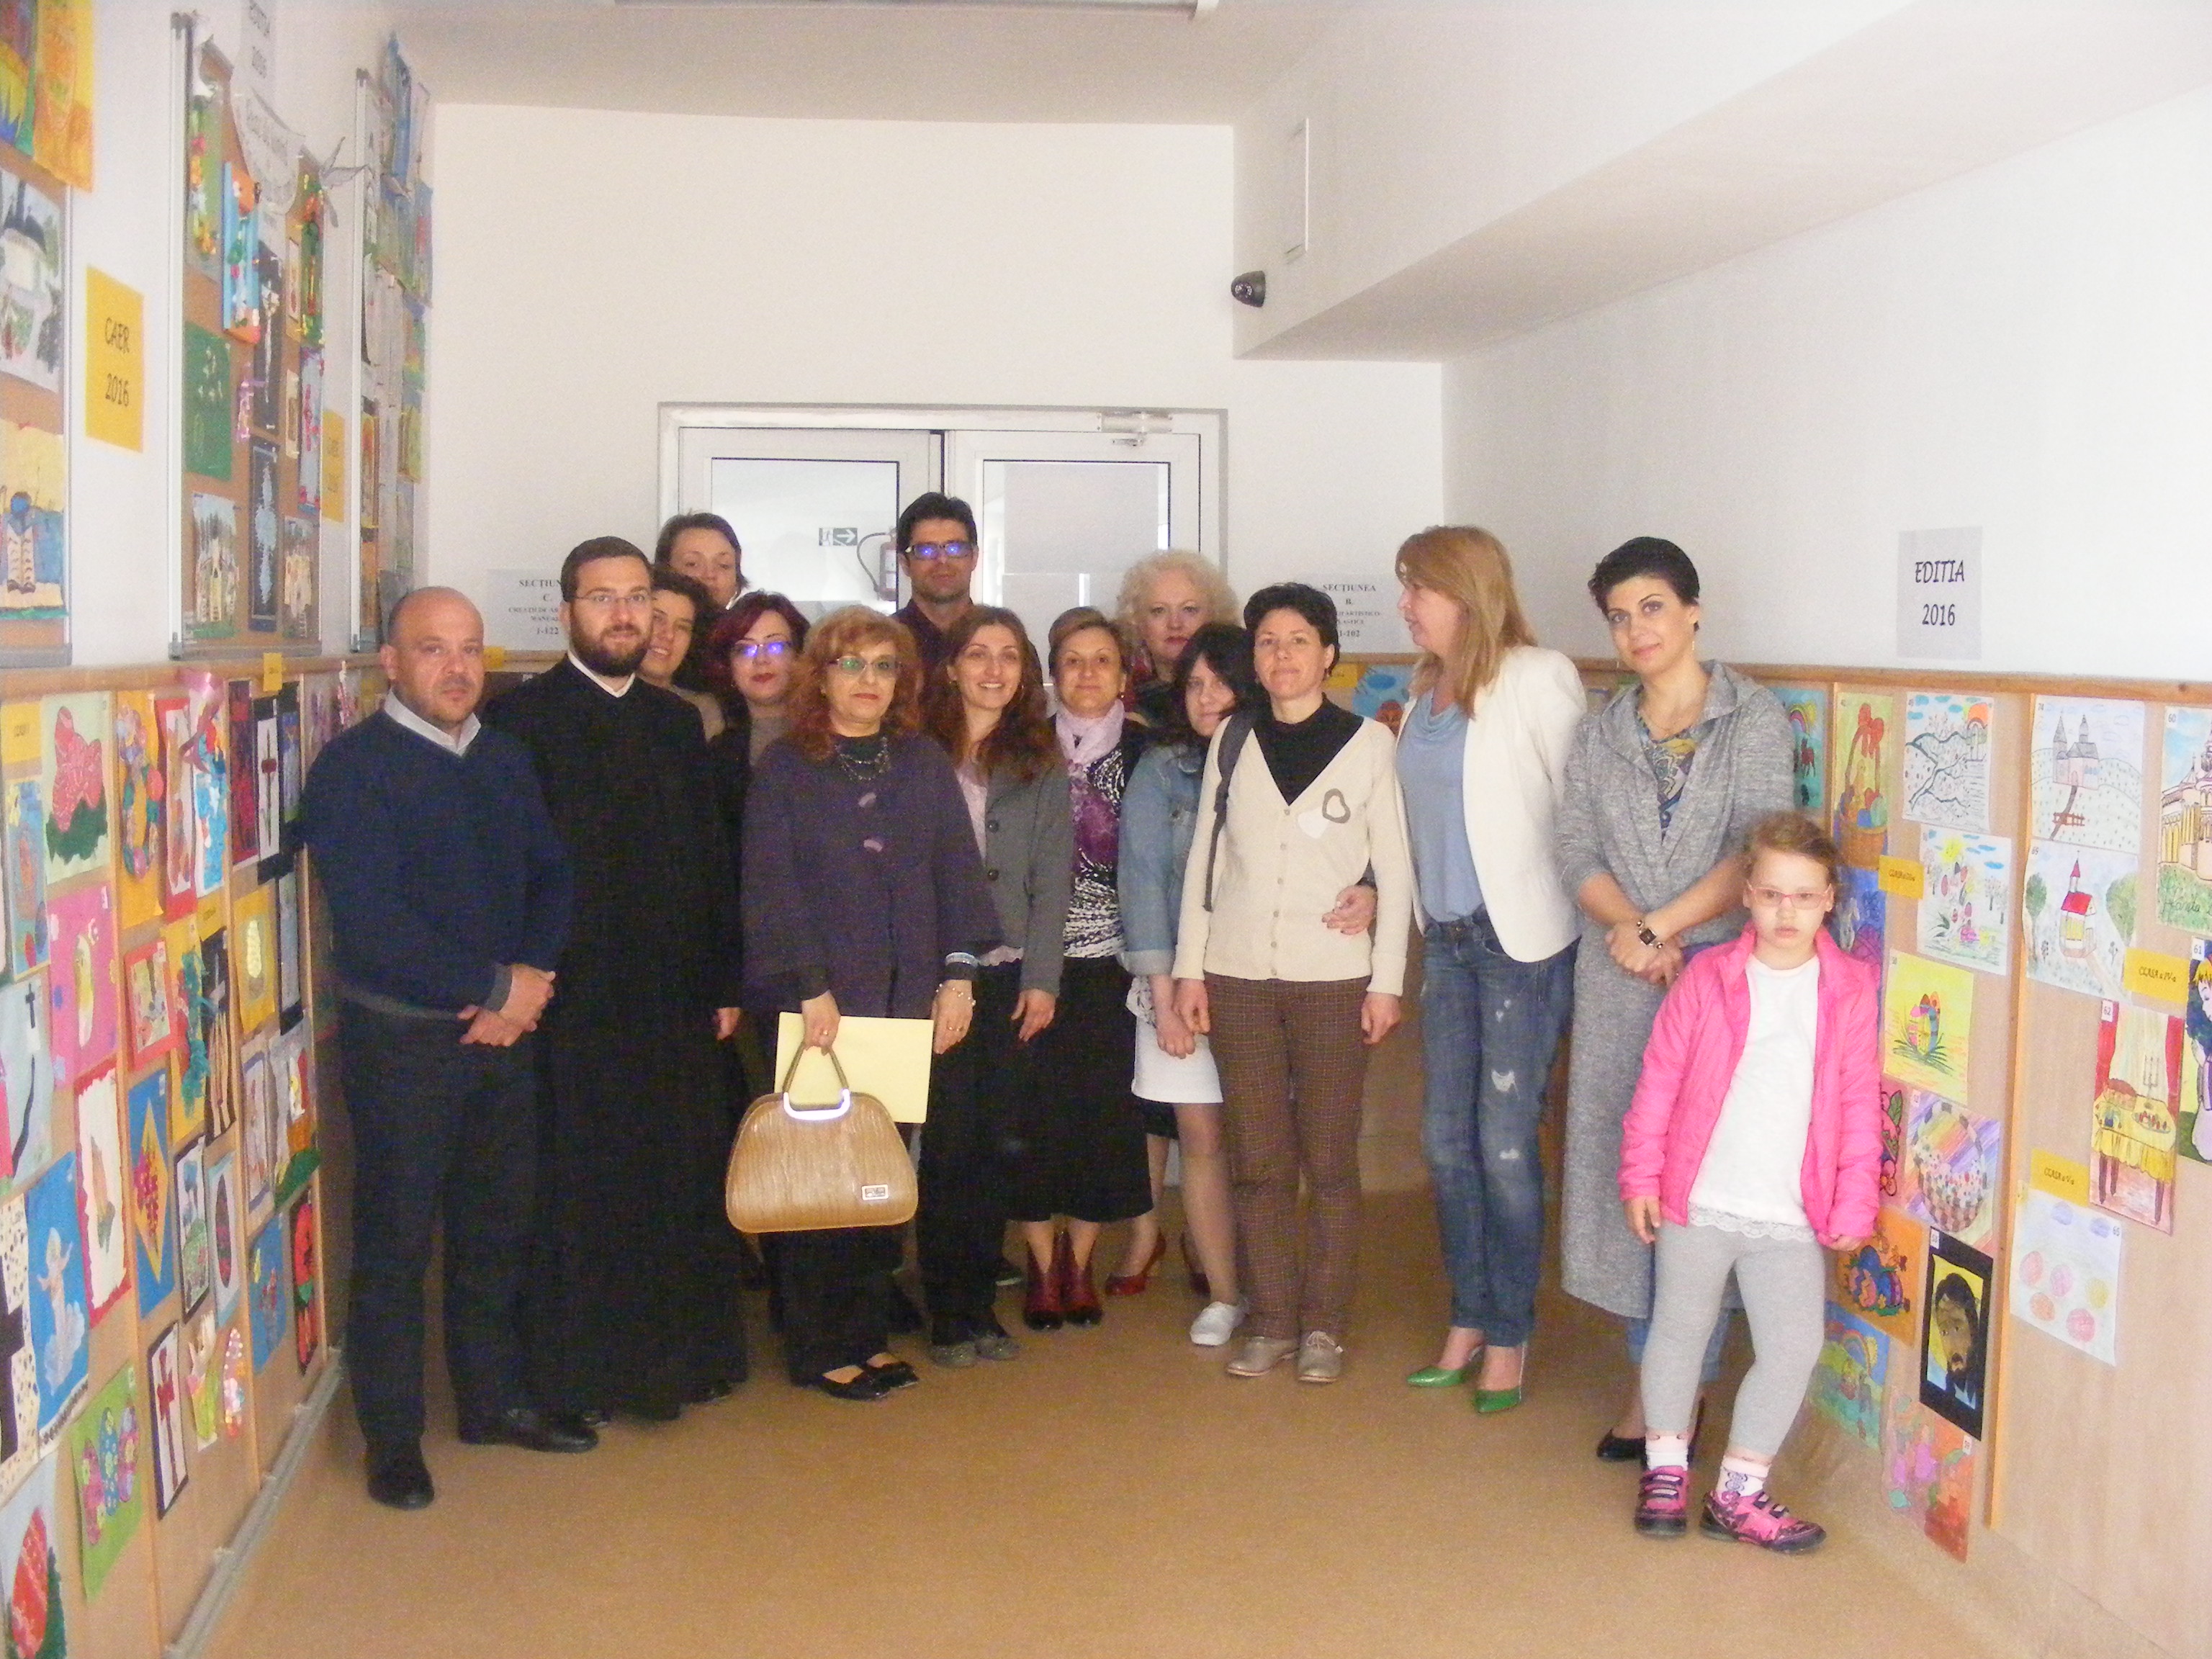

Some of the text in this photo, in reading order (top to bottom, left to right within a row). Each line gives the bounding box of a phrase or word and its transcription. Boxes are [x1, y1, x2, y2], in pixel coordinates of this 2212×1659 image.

[104, 317, 130, 354] CAER
[105, 373, 130, 407] 2016
[1915, 560, 1964, 583] EDITIA
[1922, 603, 1956, 626] 2016
[2193, 944, 2202, 955] 61
